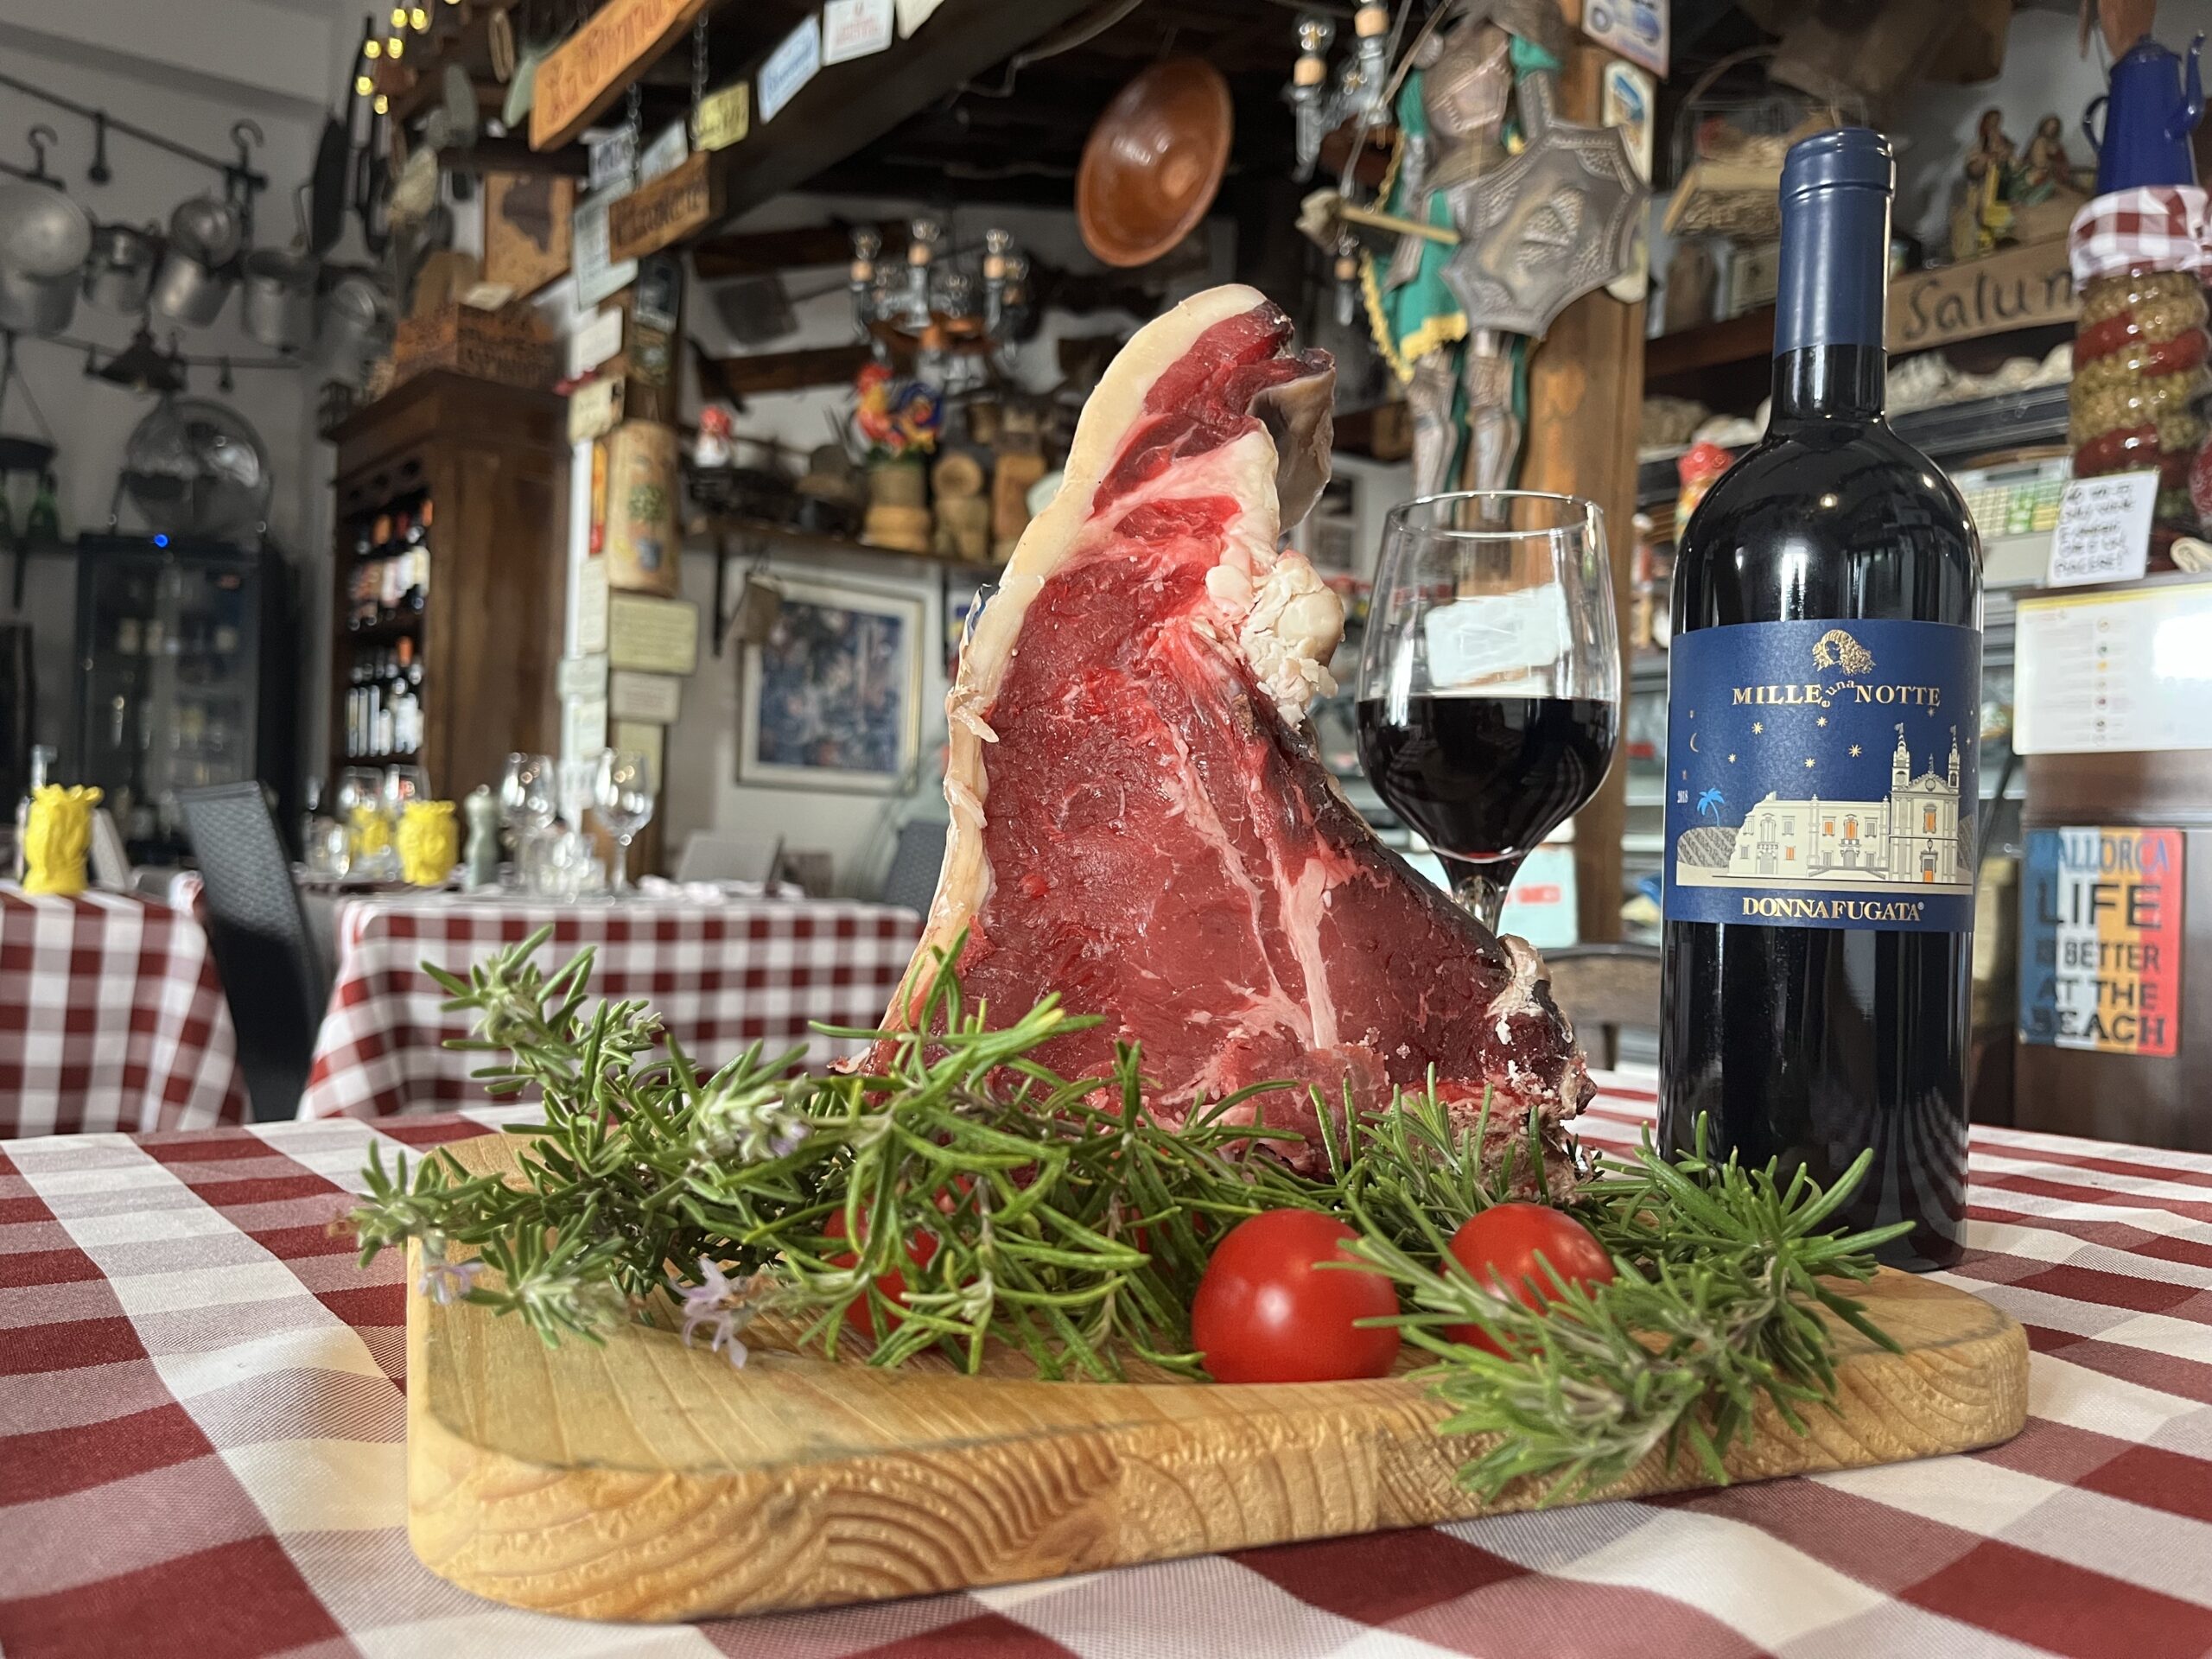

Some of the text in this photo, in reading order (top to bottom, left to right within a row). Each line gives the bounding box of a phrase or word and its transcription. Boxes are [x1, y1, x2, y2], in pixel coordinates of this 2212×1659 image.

[1732, 683, 1822, 705] MILLE
[1825, 680, 1854, 696] una
[1853, 684, 1941, 707] NOTTE
[2031, 837, 2170, 874] ALLORCA
[2039, 881, 2161, 929] LIFE
[2064, 940, 2159, 972] BETTER
[2091, 980, 2158, 1010] THE
